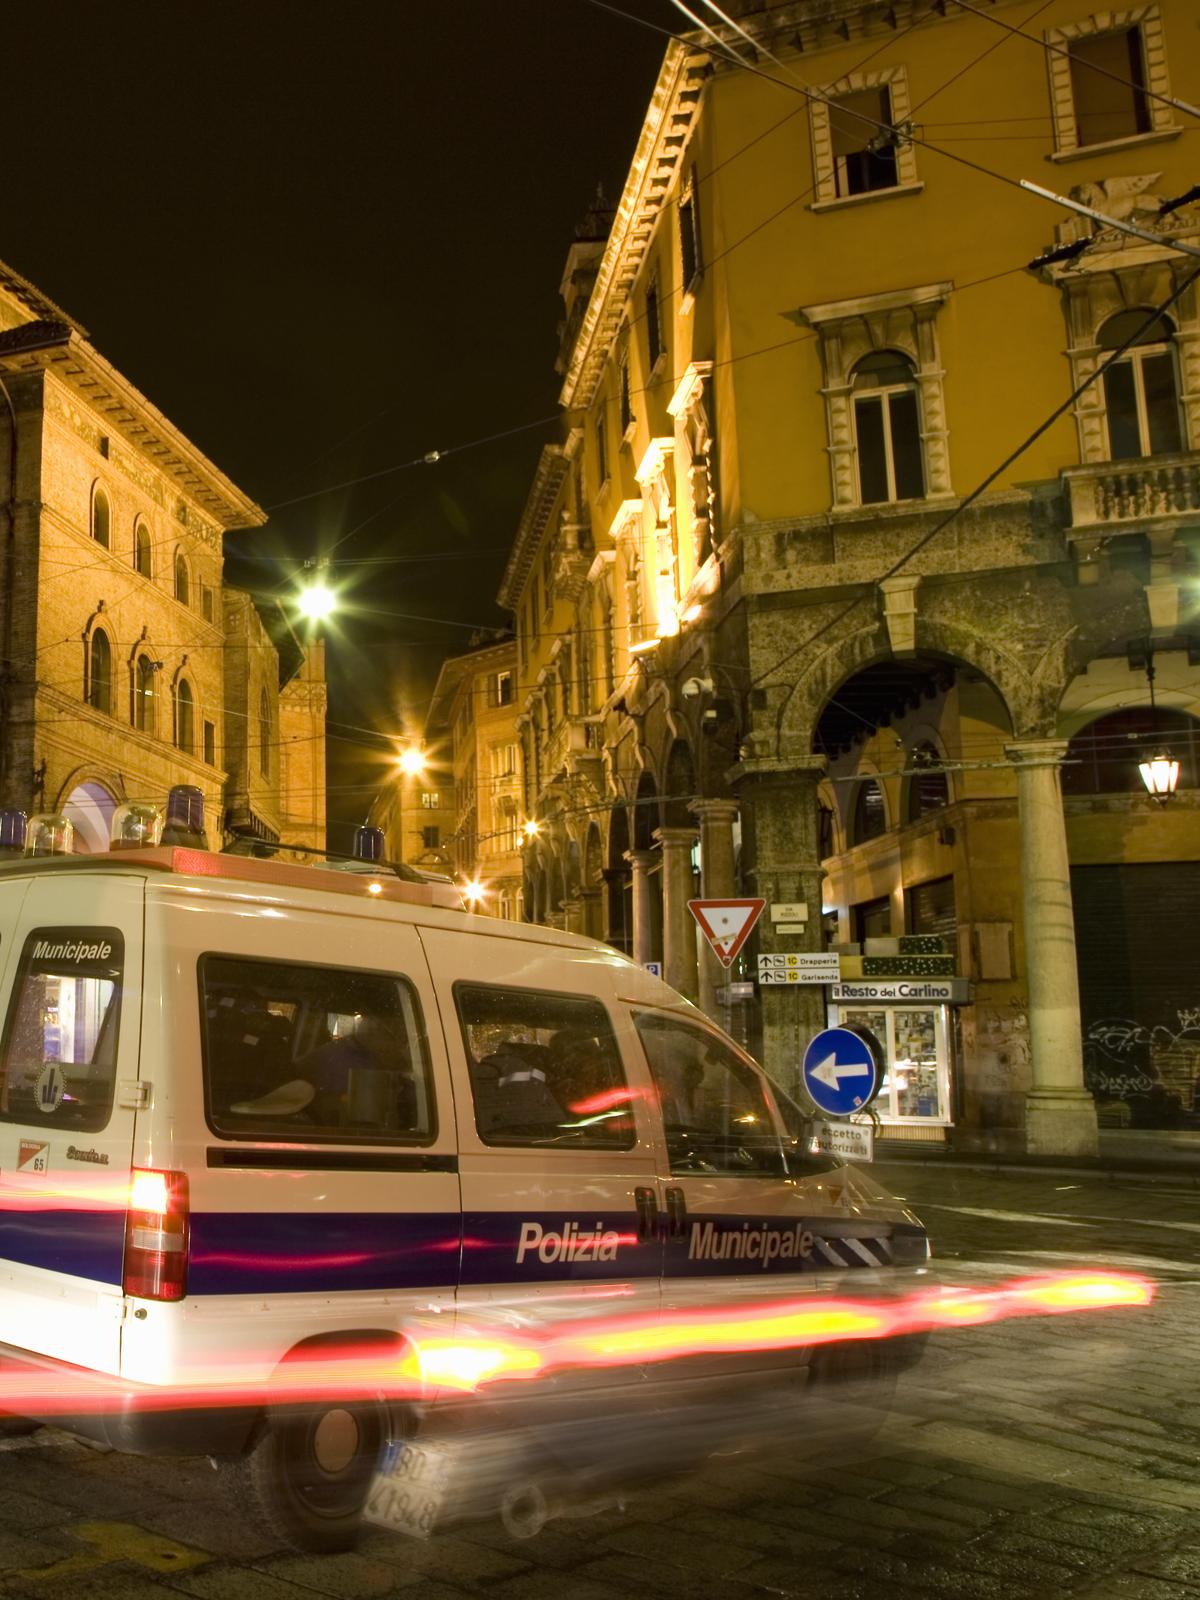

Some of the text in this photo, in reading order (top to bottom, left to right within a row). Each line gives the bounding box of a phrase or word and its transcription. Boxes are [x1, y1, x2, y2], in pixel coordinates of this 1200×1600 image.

[32, 940, 112, 963] Municipale
[800, 957, 837, 966] Drapperie
[801, 973, 838, 981] Garisenda
[834, 984, 949, 997] il Resto del Carlino
[822, 1127, 862, 1140] eccetto
[33, 1158, 44, 1171] 65
[516, 1222, 814, 1268] Polizia Municipale
